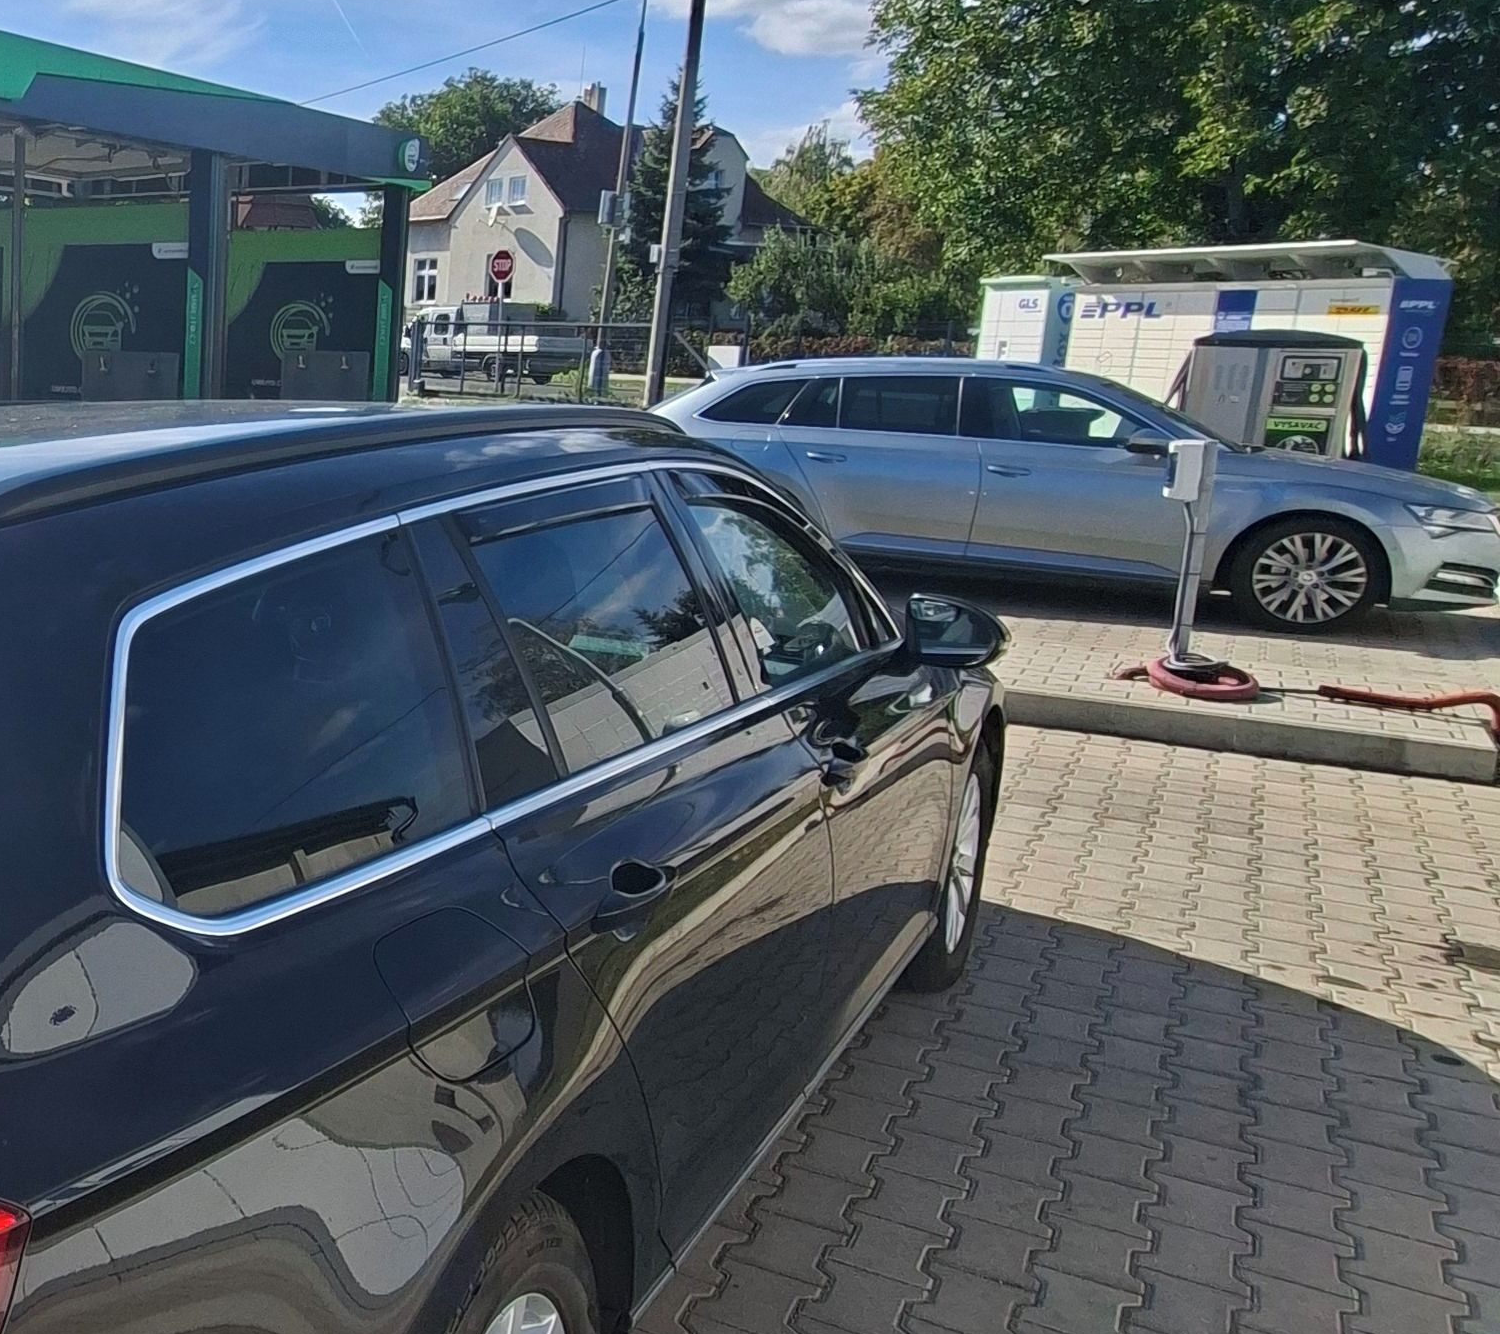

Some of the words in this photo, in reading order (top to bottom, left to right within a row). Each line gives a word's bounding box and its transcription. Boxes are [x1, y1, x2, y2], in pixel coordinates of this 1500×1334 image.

[493, 259, 512, 271] STOP
[1018, 298, 1039, 309] GLS
[1098, 302, 1163, 319] PPL
